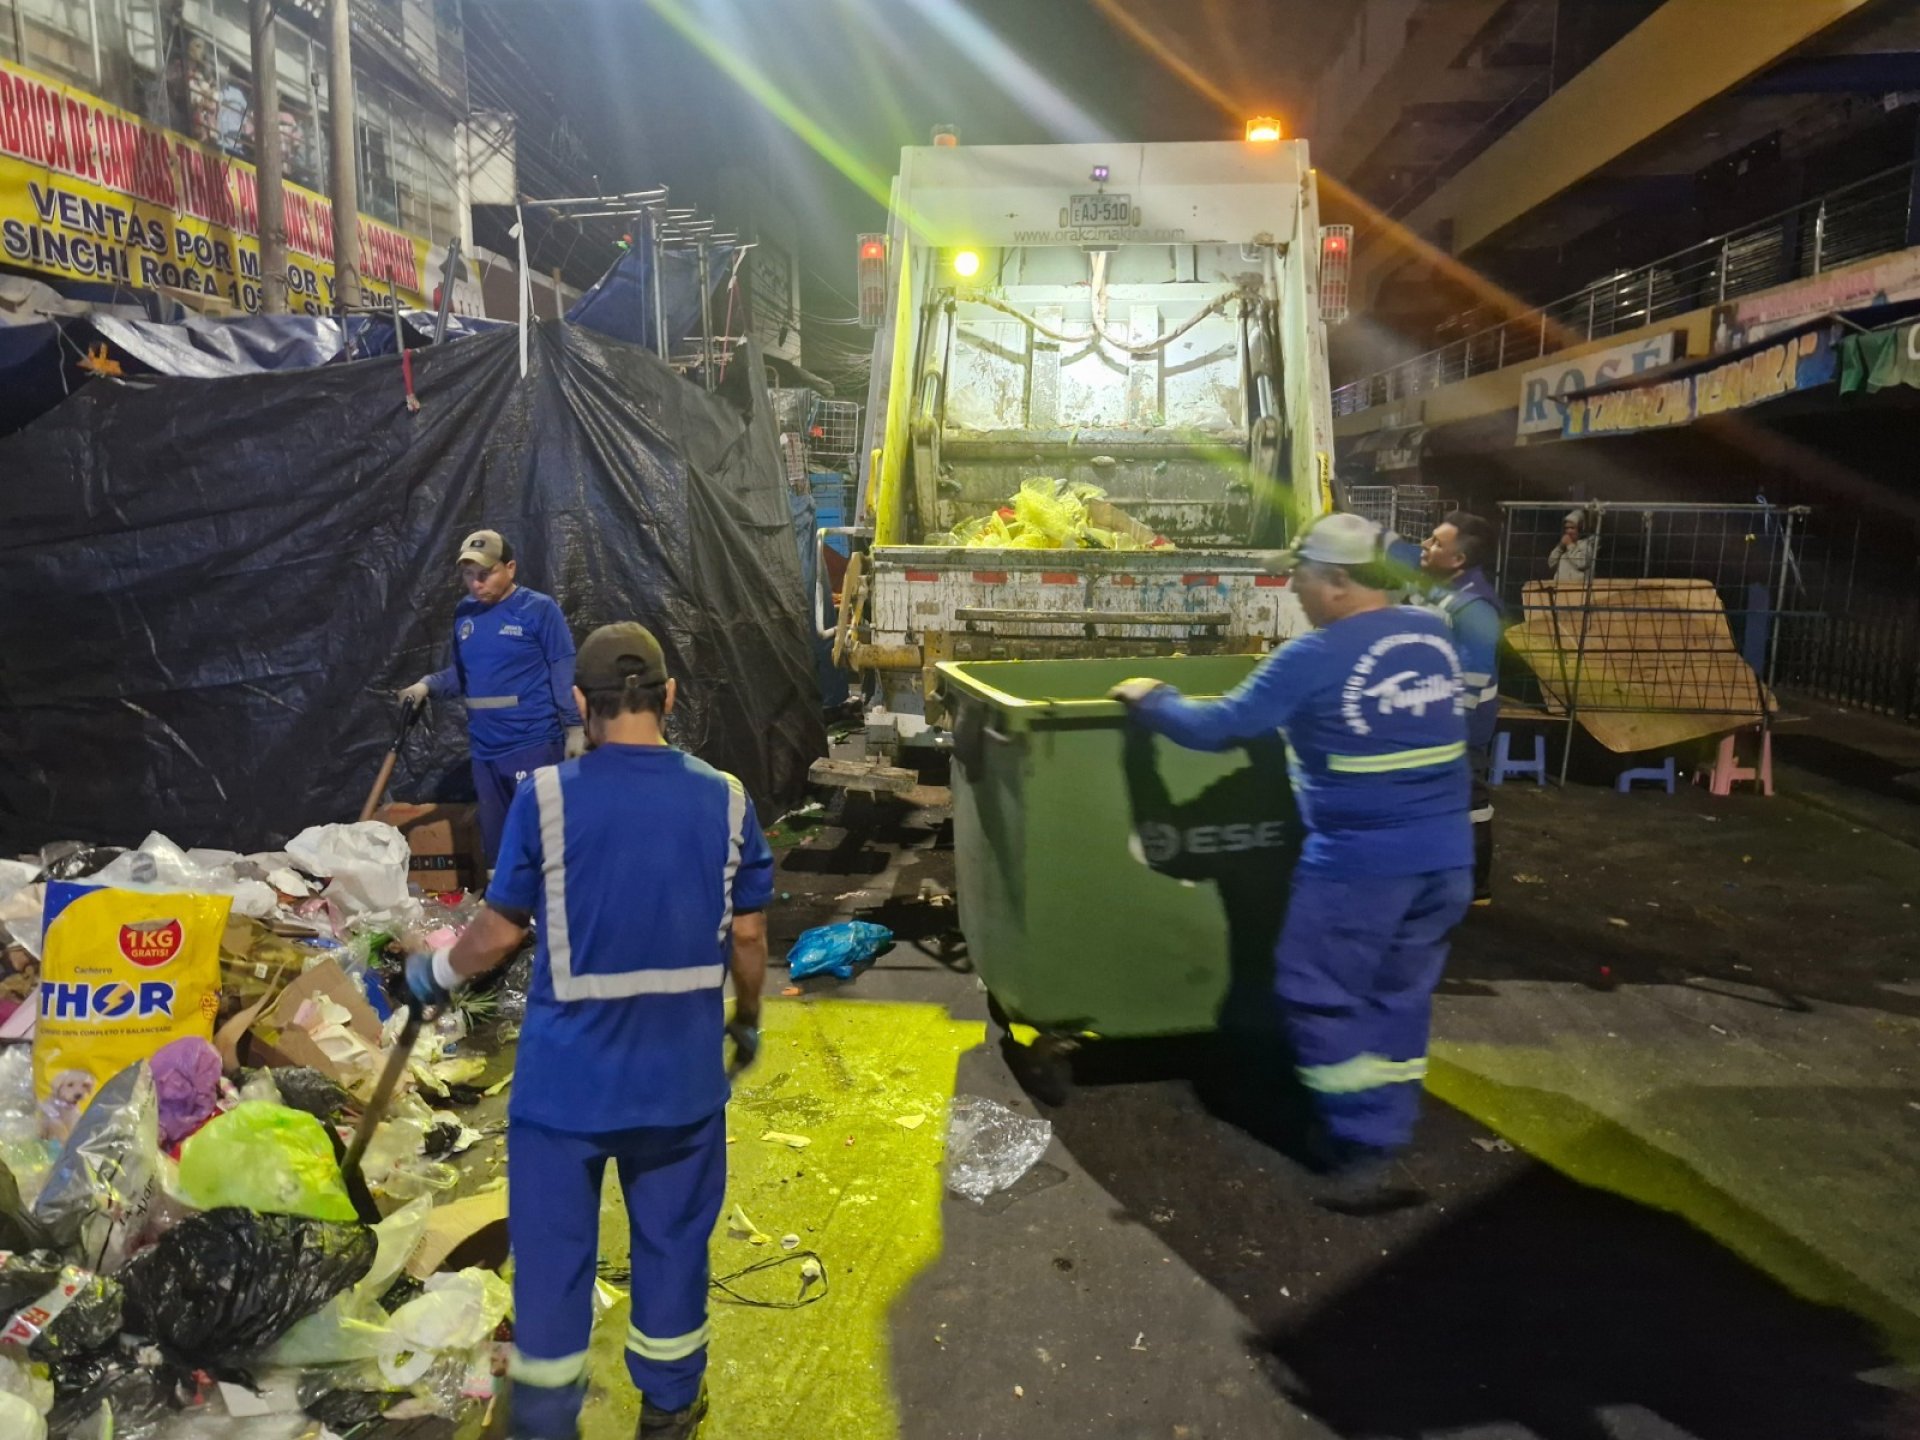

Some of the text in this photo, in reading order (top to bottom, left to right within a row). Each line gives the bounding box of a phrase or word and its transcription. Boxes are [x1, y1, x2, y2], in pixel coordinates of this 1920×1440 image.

[66, 97, 97, 180] DE
[95, 108, 182, 221] CAMISAS,
[176, 142, 242, 241] TERNOS,
[1074, 203, 1127, 222] EAJ-510
[3, 218, 131, 283] SINCHI
[140, 254, 220, 296] ROCA
[28, 181, 168, 255] VENTAS
[175, 227, 234, 276] POR
[239, 247, 320, 299] MOR
[1185, 821, 1288, 854] ESE
[126, 930, 174, 948] 1 KG
[131, 949, 169, 958] GRATIS!
[41, 981, 174, 1018] THOR
